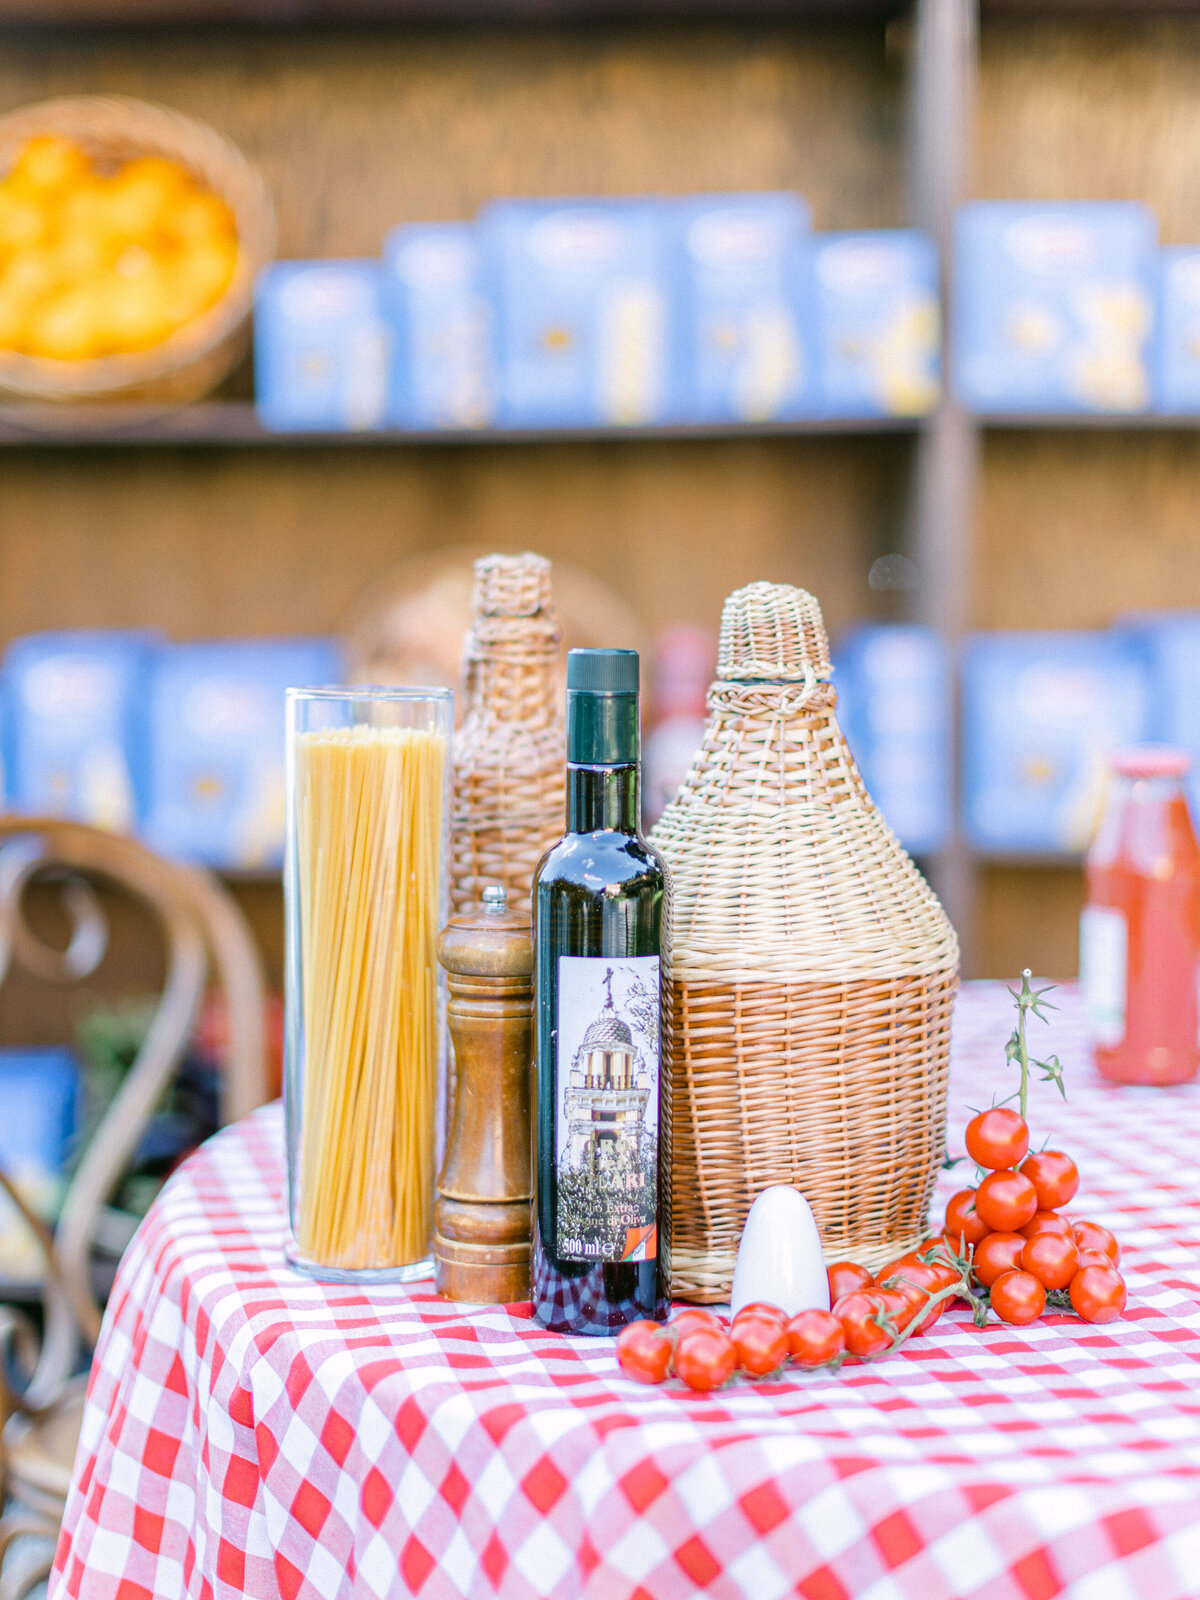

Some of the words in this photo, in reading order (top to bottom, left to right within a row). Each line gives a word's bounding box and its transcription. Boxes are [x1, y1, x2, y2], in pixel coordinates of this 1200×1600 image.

[584, 1139, 629, 1153] ORO
[607, 1203, 633, 1214] Extra
[621, 1213, 646, 1225] Oliva
[562, 1238, 582, 1254] 500
[585, 1239, 600, 1255] ml
